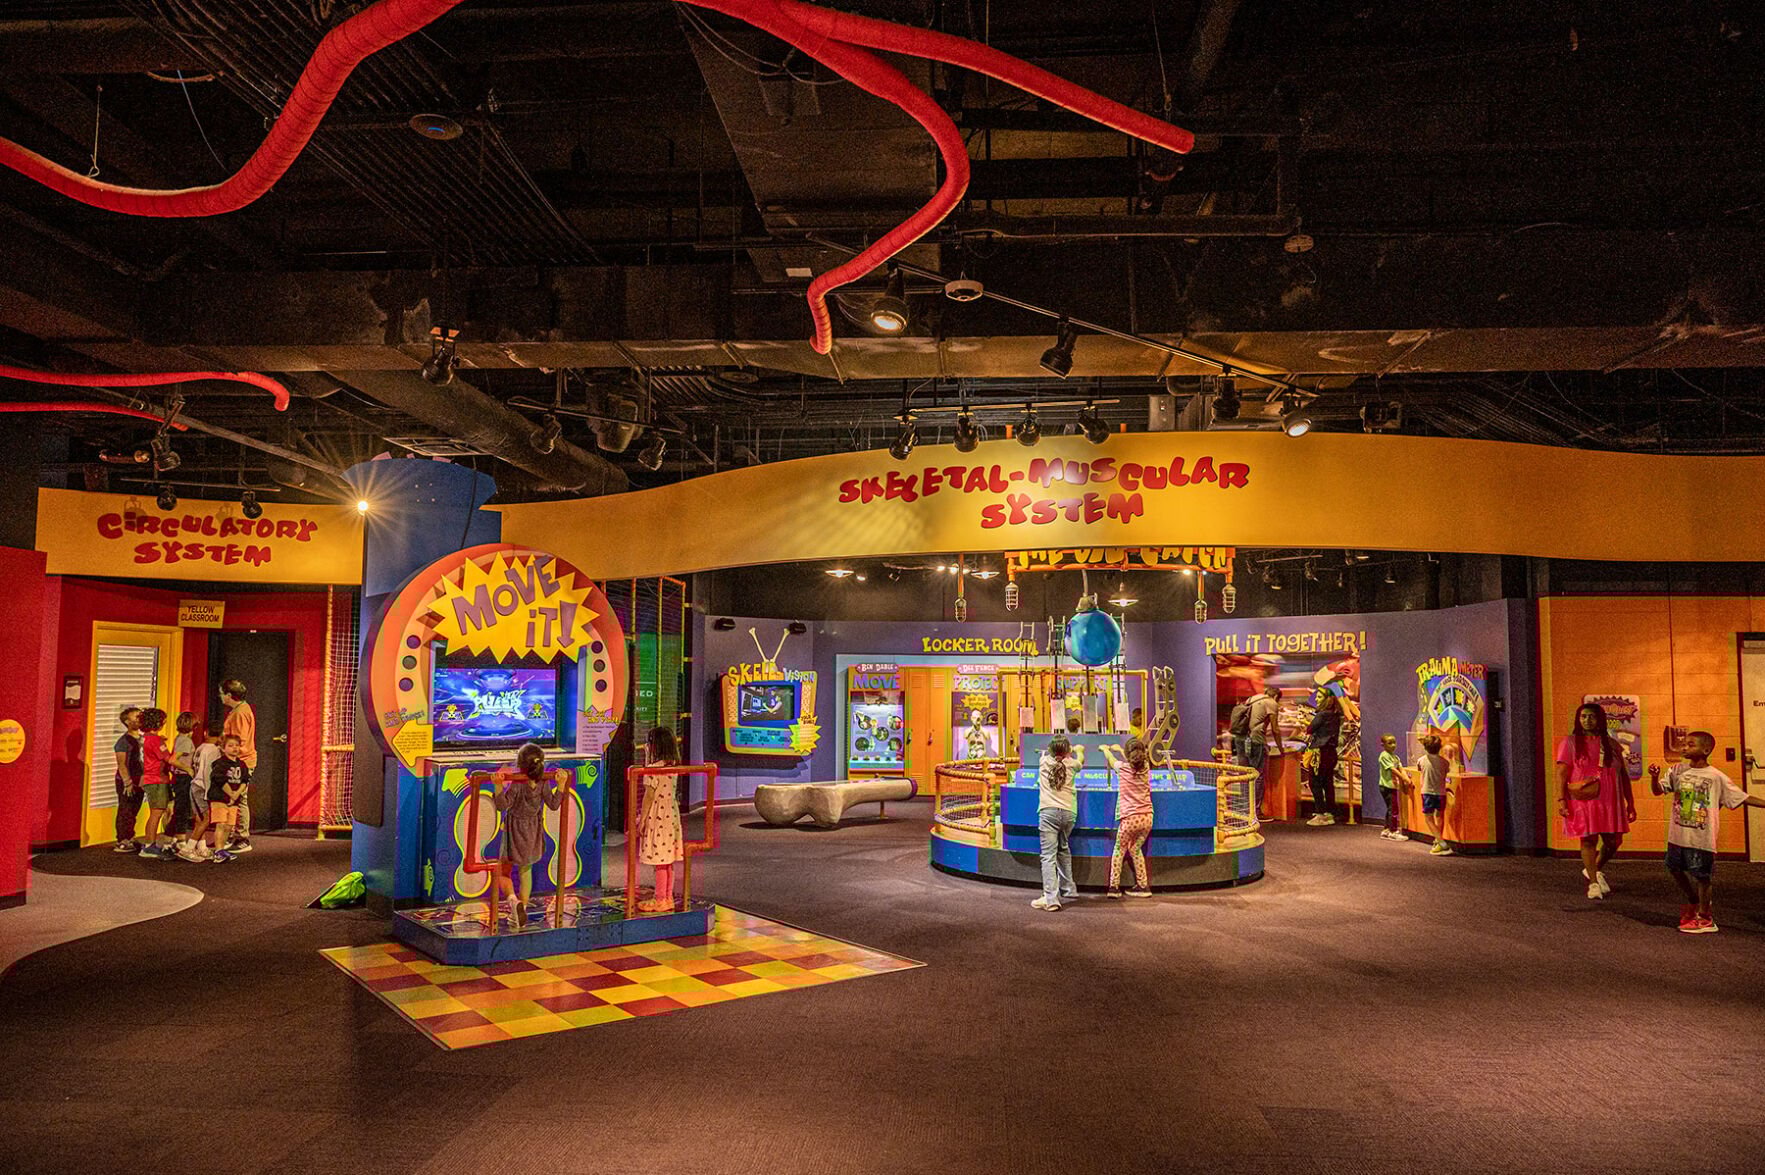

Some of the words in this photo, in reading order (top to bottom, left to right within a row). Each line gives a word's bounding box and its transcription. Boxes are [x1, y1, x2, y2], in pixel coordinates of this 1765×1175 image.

[838, 456, 1250, 503] SKELETAL-MUSCULAR
[981, 492, 1143, 528] SYSTEM
[134, 541, 271, 567] SYSTEM
[451, 555, 561, 636] MOVE
[181, 613, 220, 622] CLASSROOM
[187, 605, 216, 614] YELLOW
[922, 637, 990, 654] LOCKER
[1204, 634, 1239, 655] PULL
[854, 673, 901, 689] MOVE
[1416, 656, 1459, 686] TRAUMA
